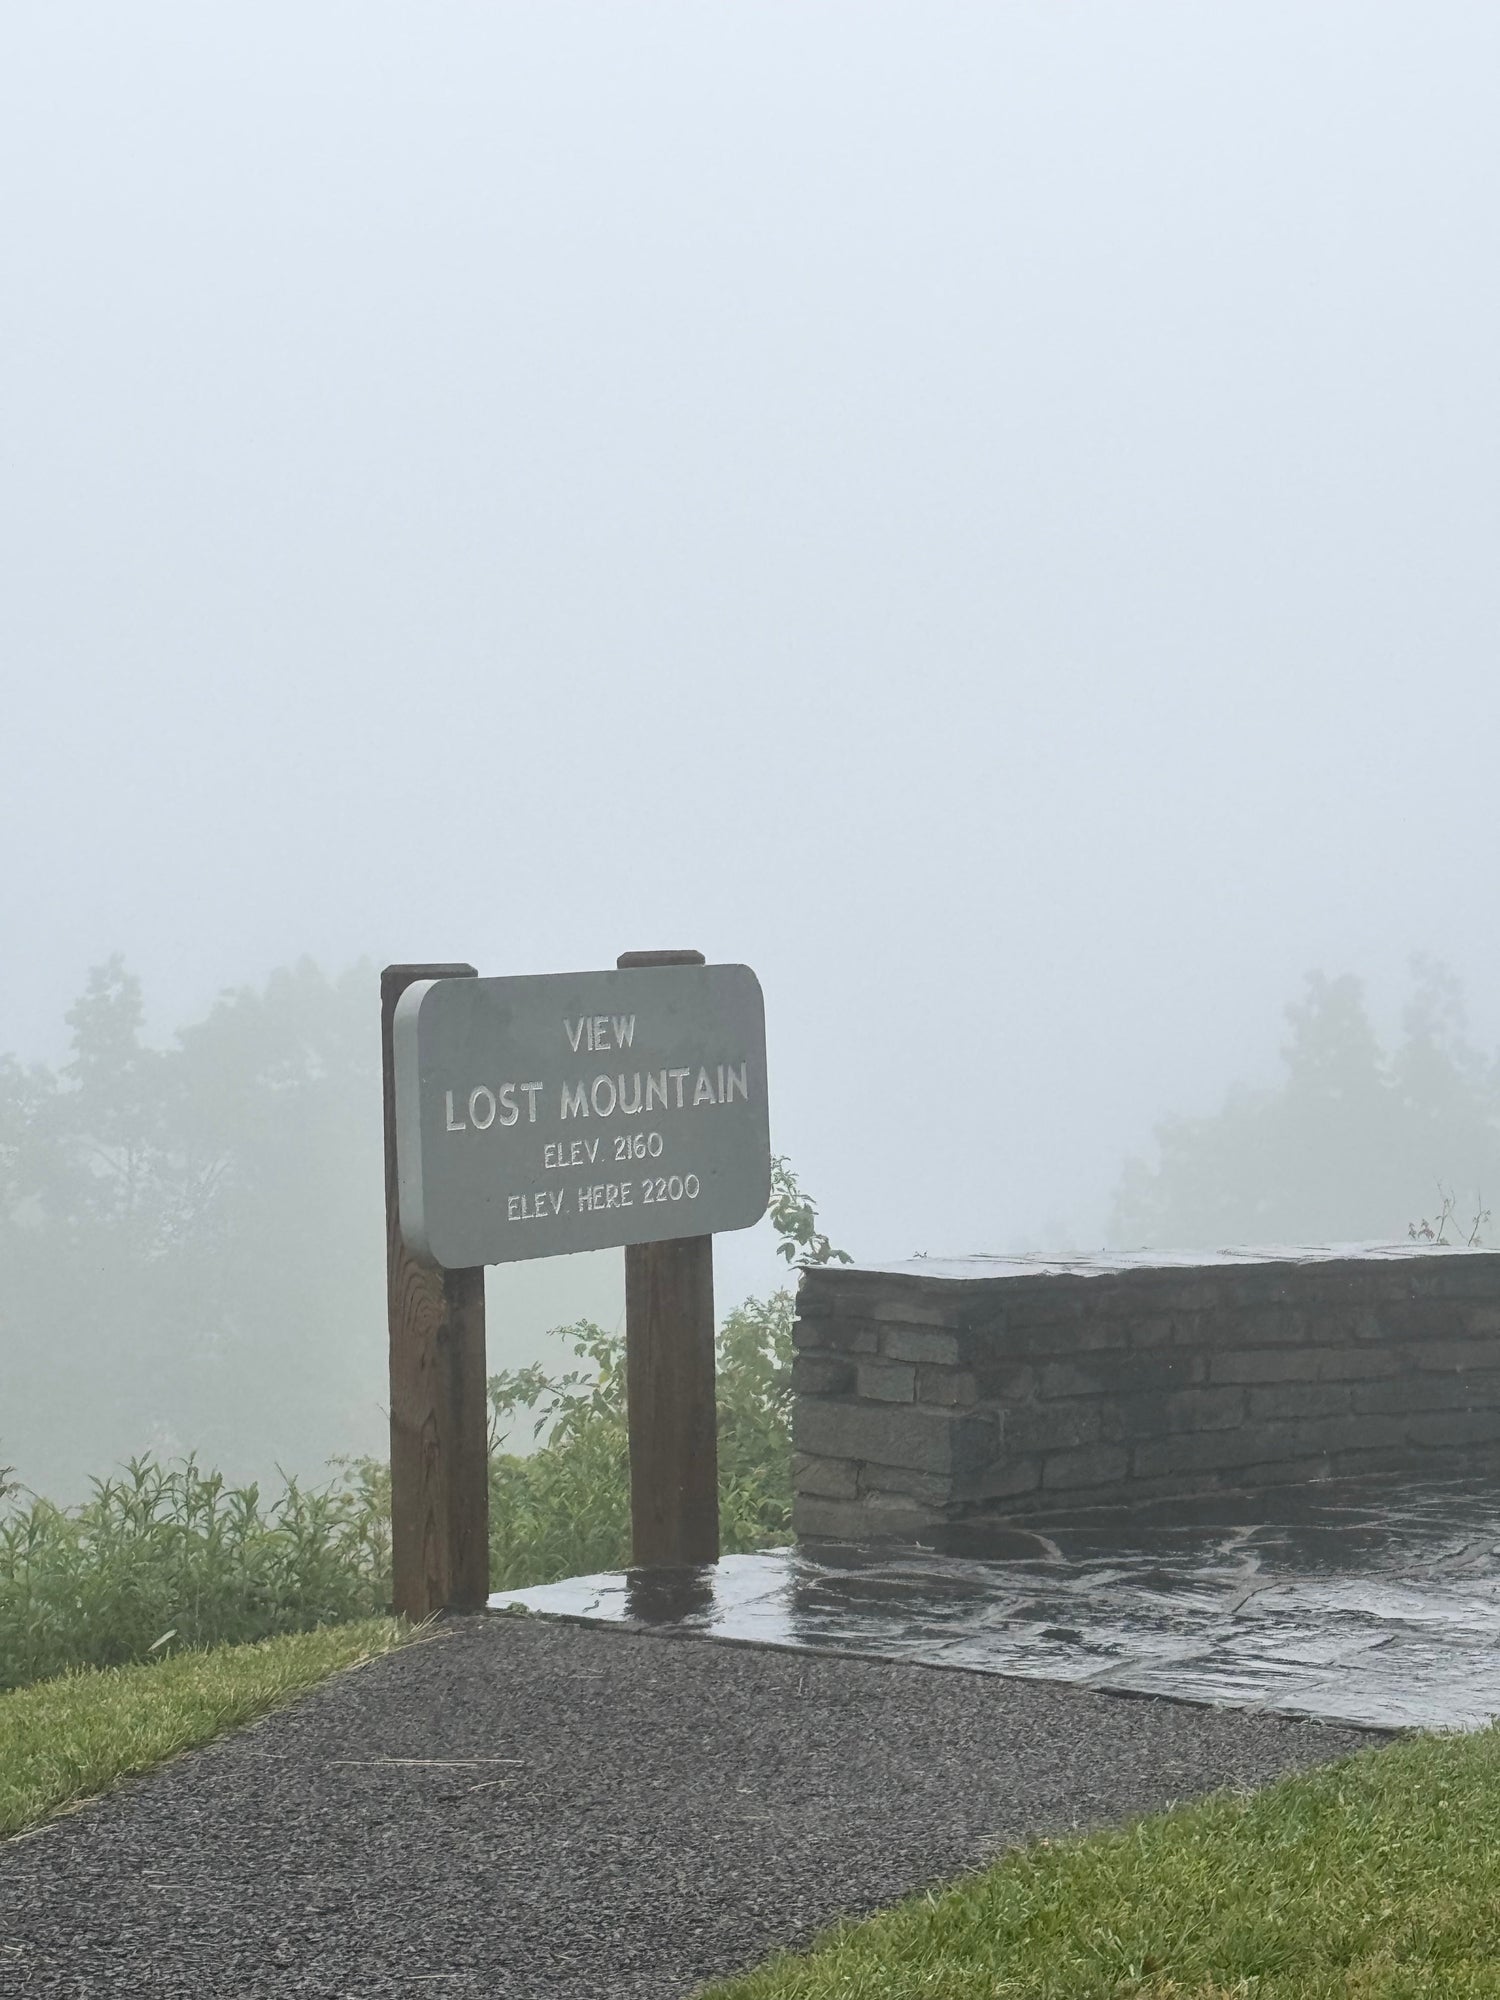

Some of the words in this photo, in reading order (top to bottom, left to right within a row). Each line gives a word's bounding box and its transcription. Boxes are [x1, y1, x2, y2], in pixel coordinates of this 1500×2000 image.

[563, 1015, 636, 1053] VIEW
[445, 1081, 544, 1132] LOST
[560, 1062, 749, 1120] MOUNTAIN
[614, 1132, 664, 1161] 2160
[577, 1182, 635, 1213] HERE
[641, 1173, 700, 1204] 2200
